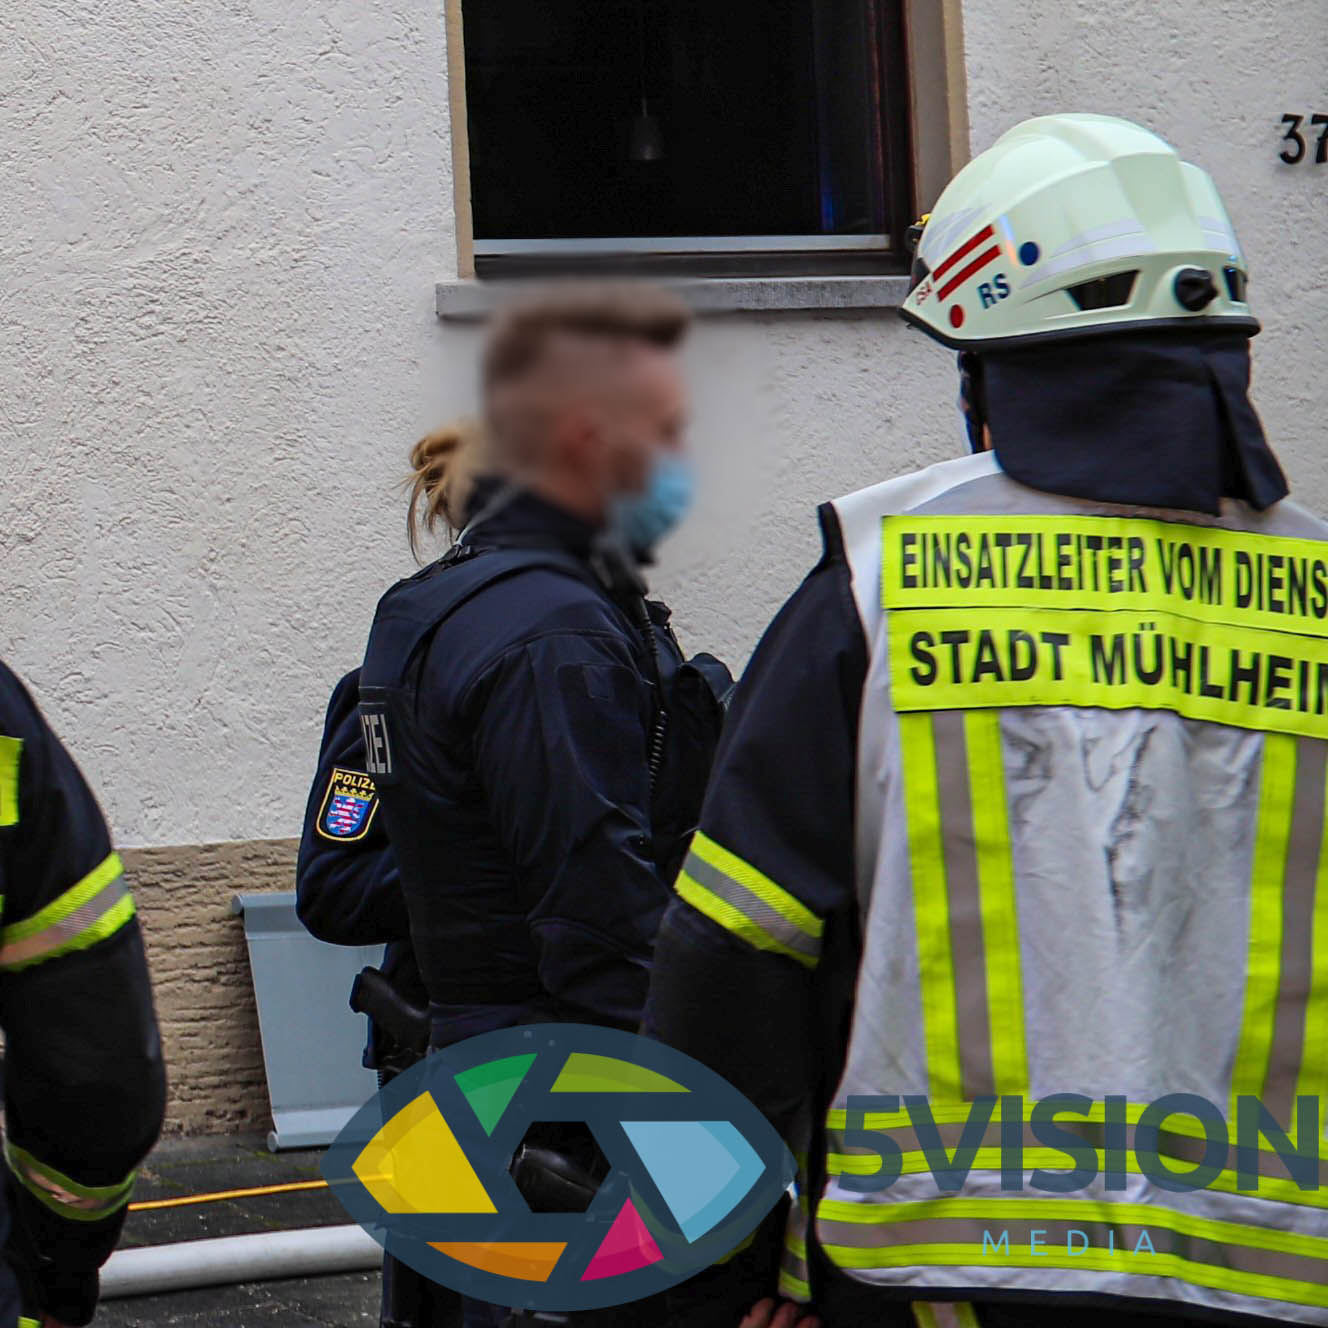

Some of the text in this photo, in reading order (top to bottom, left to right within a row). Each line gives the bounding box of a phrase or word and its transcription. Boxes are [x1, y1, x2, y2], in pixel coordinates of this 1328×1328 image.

[1280, 113, 1328, 164] 37
[977, 273, 1011, 310] RS
[900, 532, 1148, 594] EINSATZLEITER
[1157, 537, 1222, 606] VOM
[909, 629, 1071, 686] STADT
